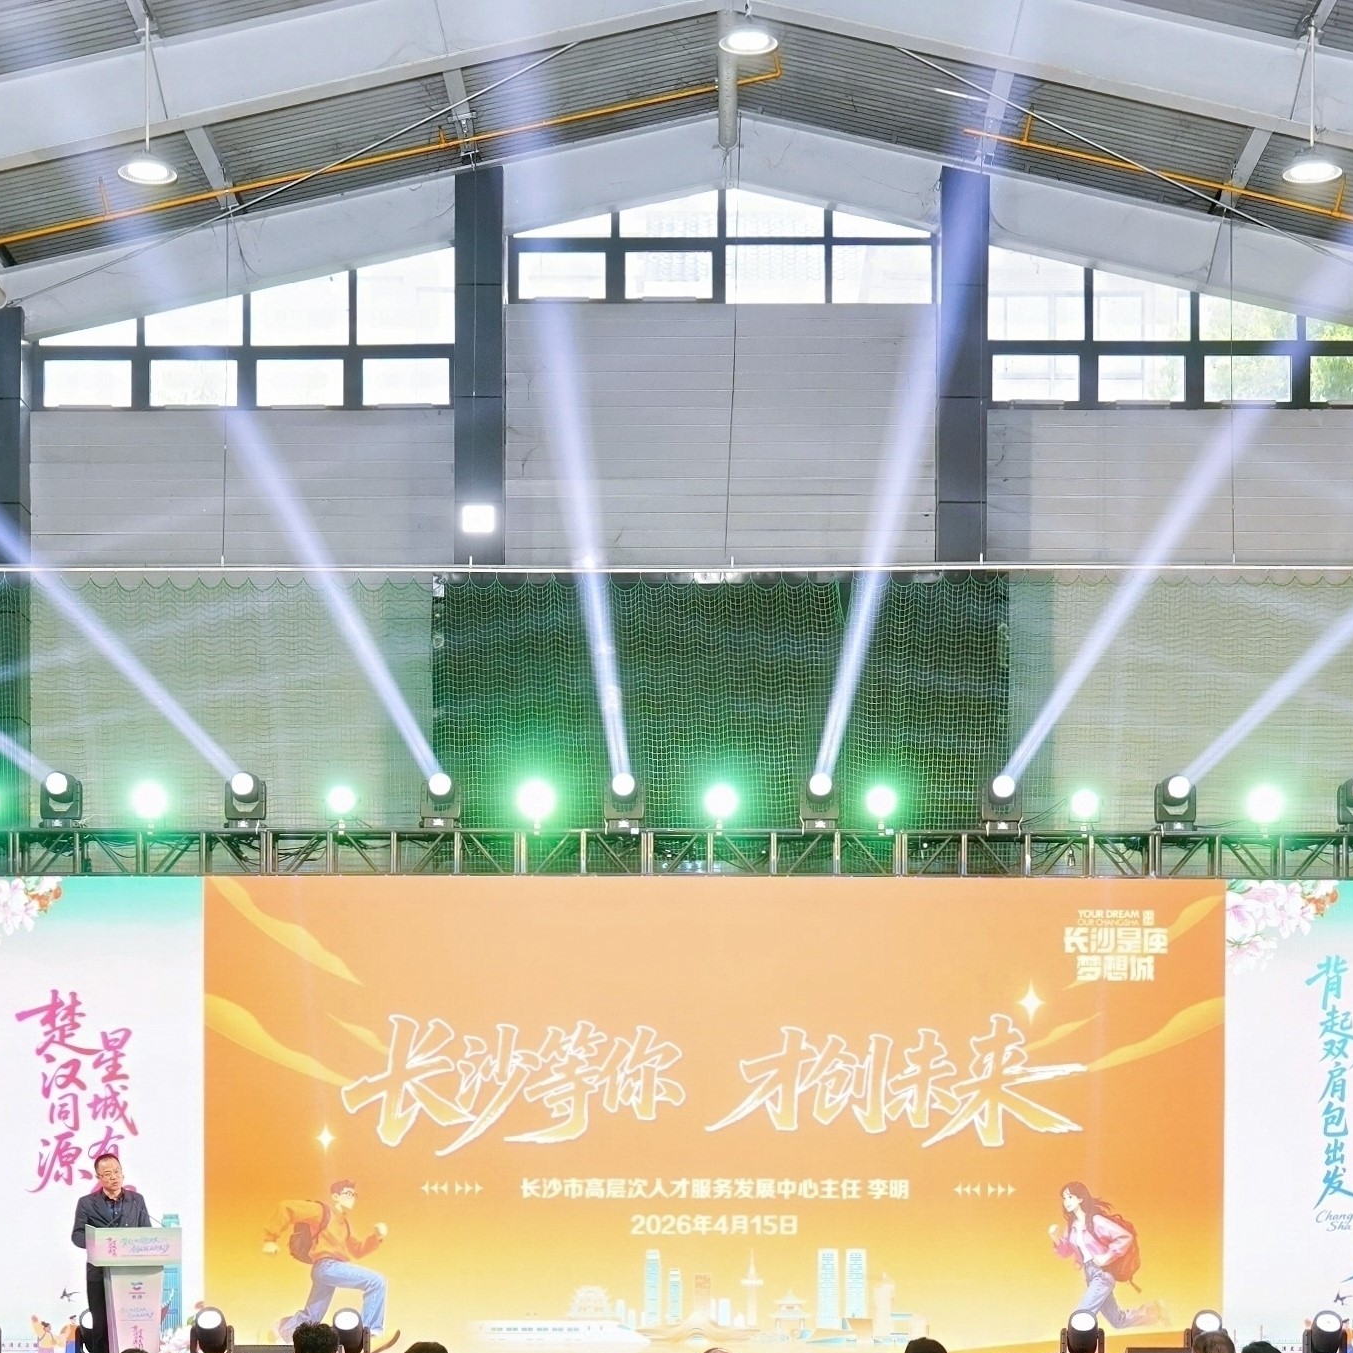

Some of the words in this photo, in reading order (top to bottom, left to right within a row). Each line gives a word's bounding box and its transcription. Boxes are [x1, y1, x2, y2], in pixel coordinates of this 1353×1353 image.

[1077, 909, 1103, 919] YOUR
[1106, 909, 1140, 919] DREAM
[1064, 926, 1168, 954] 长沙是座
[1076, 955, 1155, 982] 梦想城
[14, 988, 105, 1194] 楚汉同源
[341, 1013, 687, 1157] 长沙等你
[703, 1013, 1088, 1149] 才创未来
[85, 1026, 139, 1195] 星城有
[519, 1177, 863, 1201] 长沙市高层次人才服务发展中心主任
[866, 1178, 910, 1201] 李明
[630, 1213, 798, 1237] 2026年4月15日
[1315, 1209, 1353, 1224] Chang
[1326, 1220, 1353, 1232] Sha
